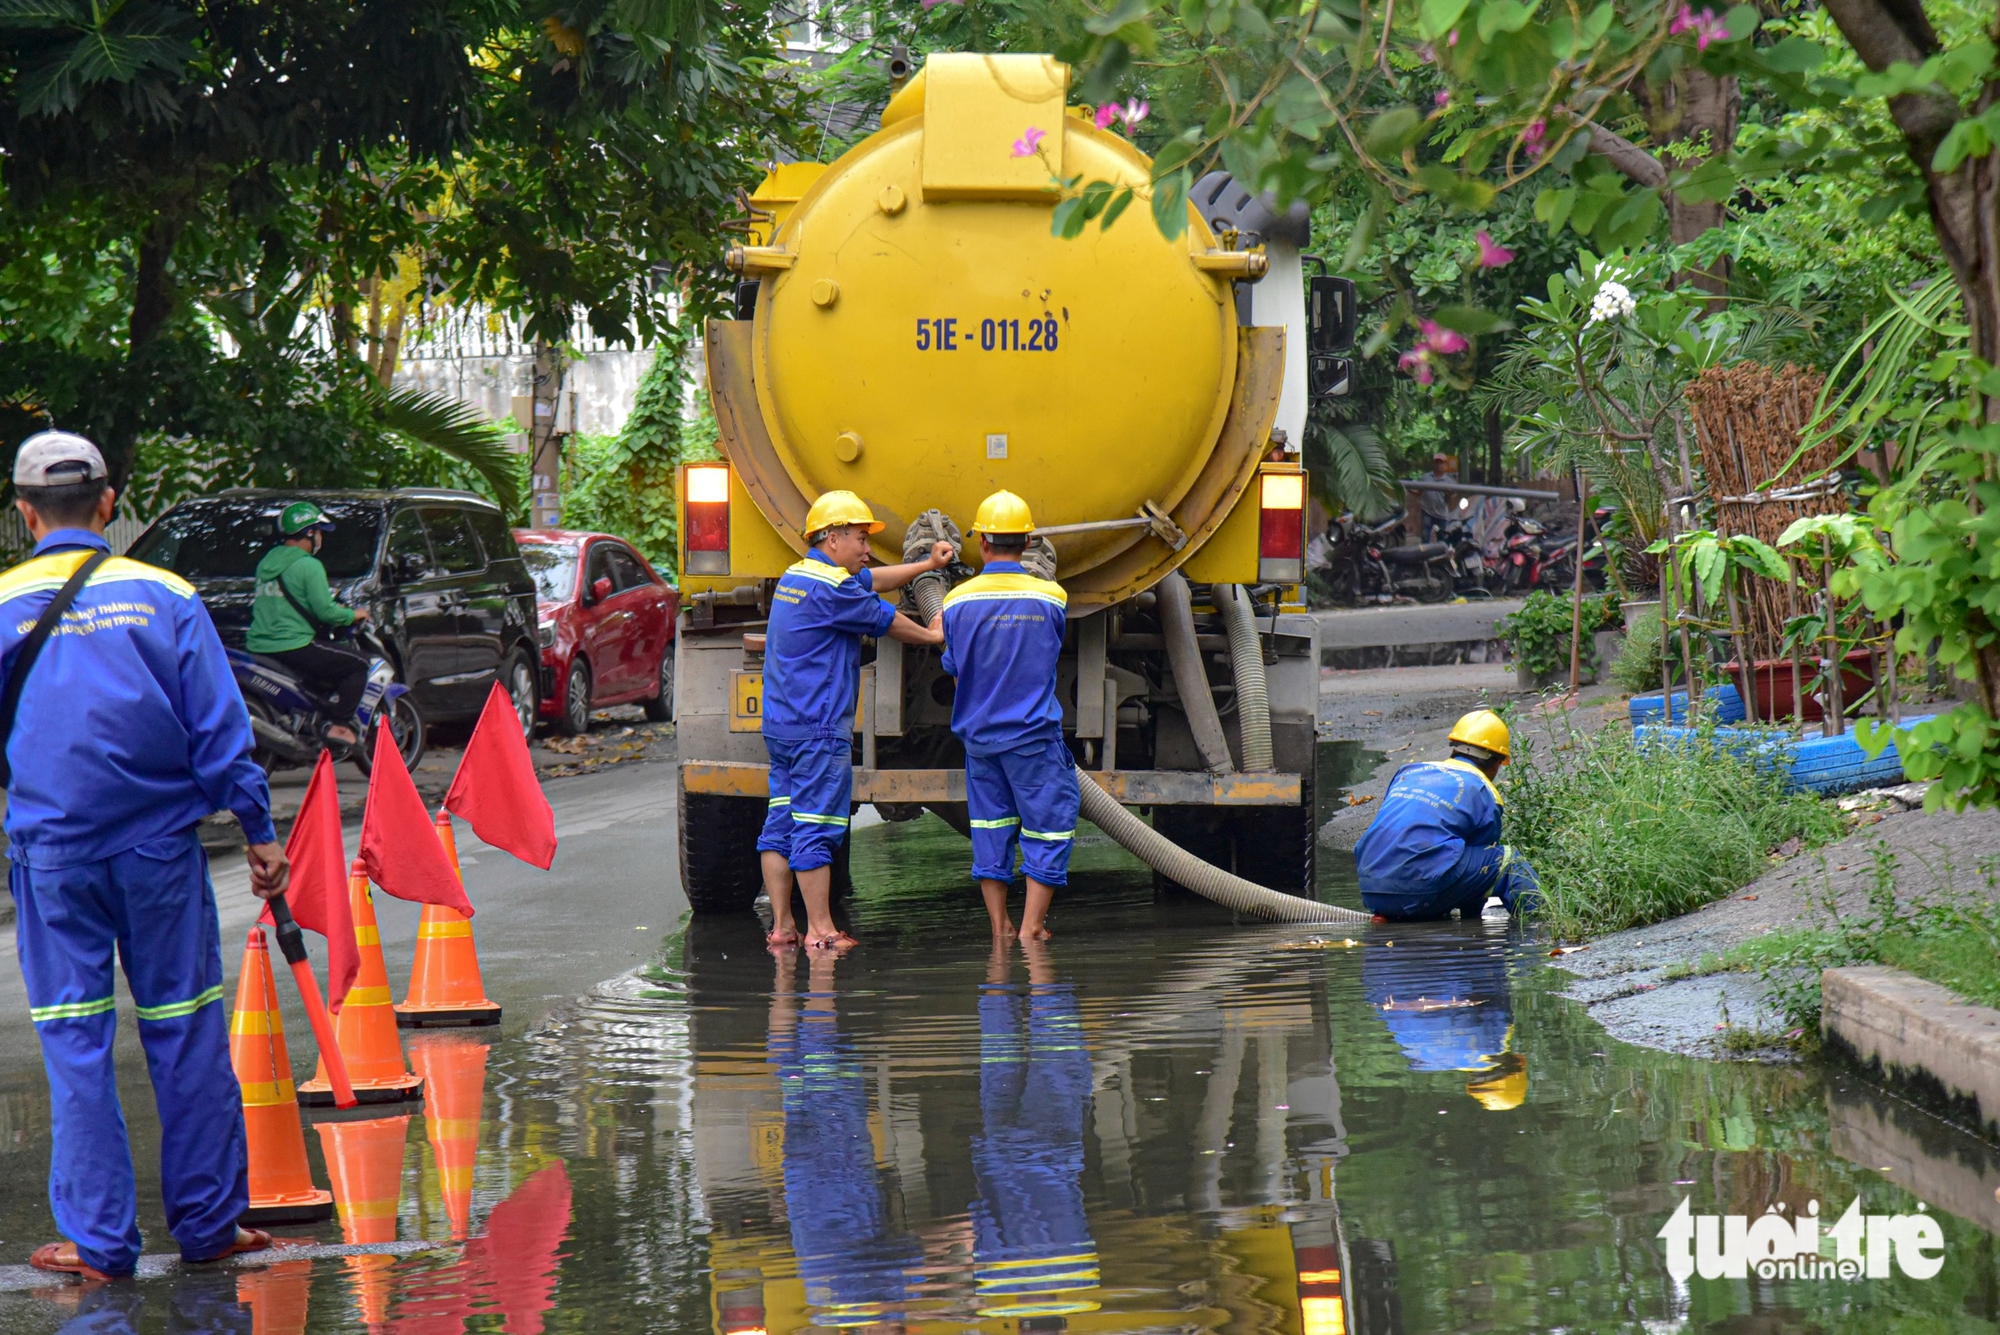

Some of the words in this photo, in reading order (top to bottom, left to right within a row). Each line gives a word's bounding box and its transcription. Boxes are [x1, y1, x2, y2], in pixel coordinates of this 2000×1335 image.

[916, 318, 957, 351] 51E
[981, 318, 1058, 352] 011.28
[98, 602, 134, 615] THÀNH
[96, 618, 113, 630] THỊ
[113, 615, 149, 627] TP.HCM
[250, 675, 282, 697] YAMAHA
